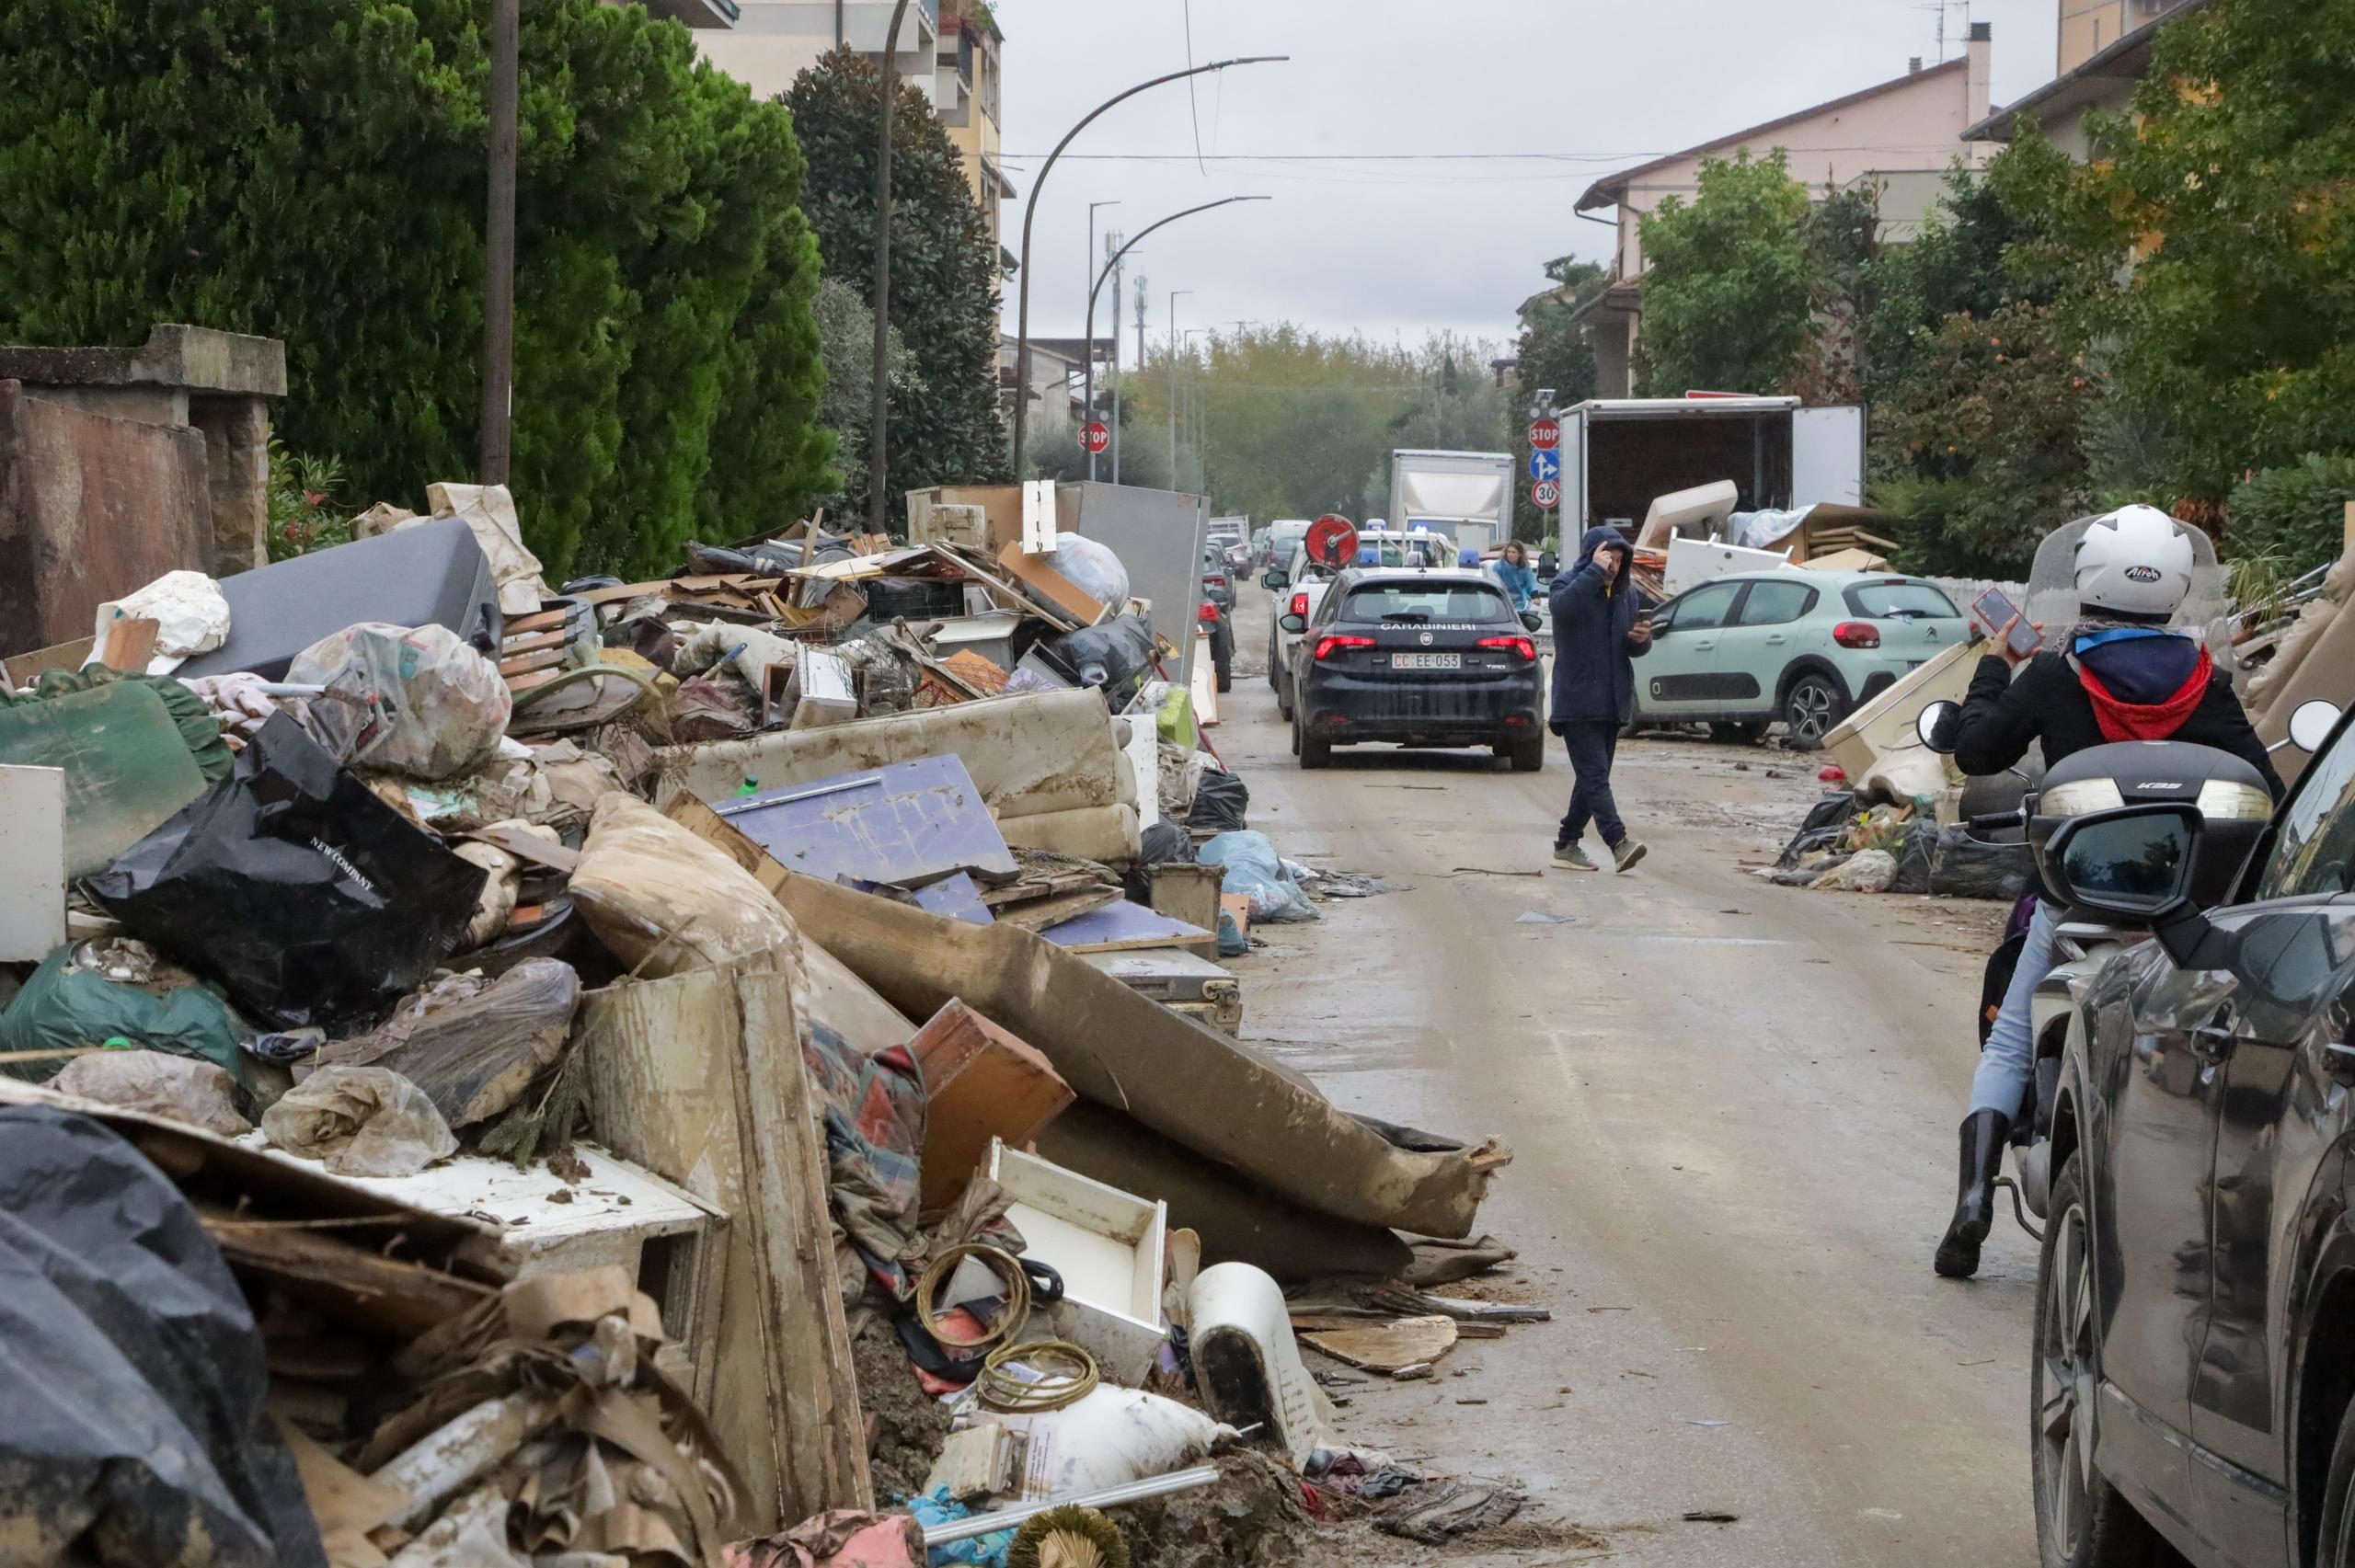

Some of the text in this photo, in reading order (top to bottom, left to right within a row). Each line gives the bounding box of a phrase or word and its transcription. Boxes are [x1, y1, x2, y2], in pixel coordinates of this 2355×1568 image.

[1081, 431, 1107, 442] SOP
[1532, 429, 1558, 441] STOP
[1538, 487, 1554, 499] 30
[1395, 655, 1458, 667] CC EE 053
[310, 836, 374, 890] NEW COMPANY
